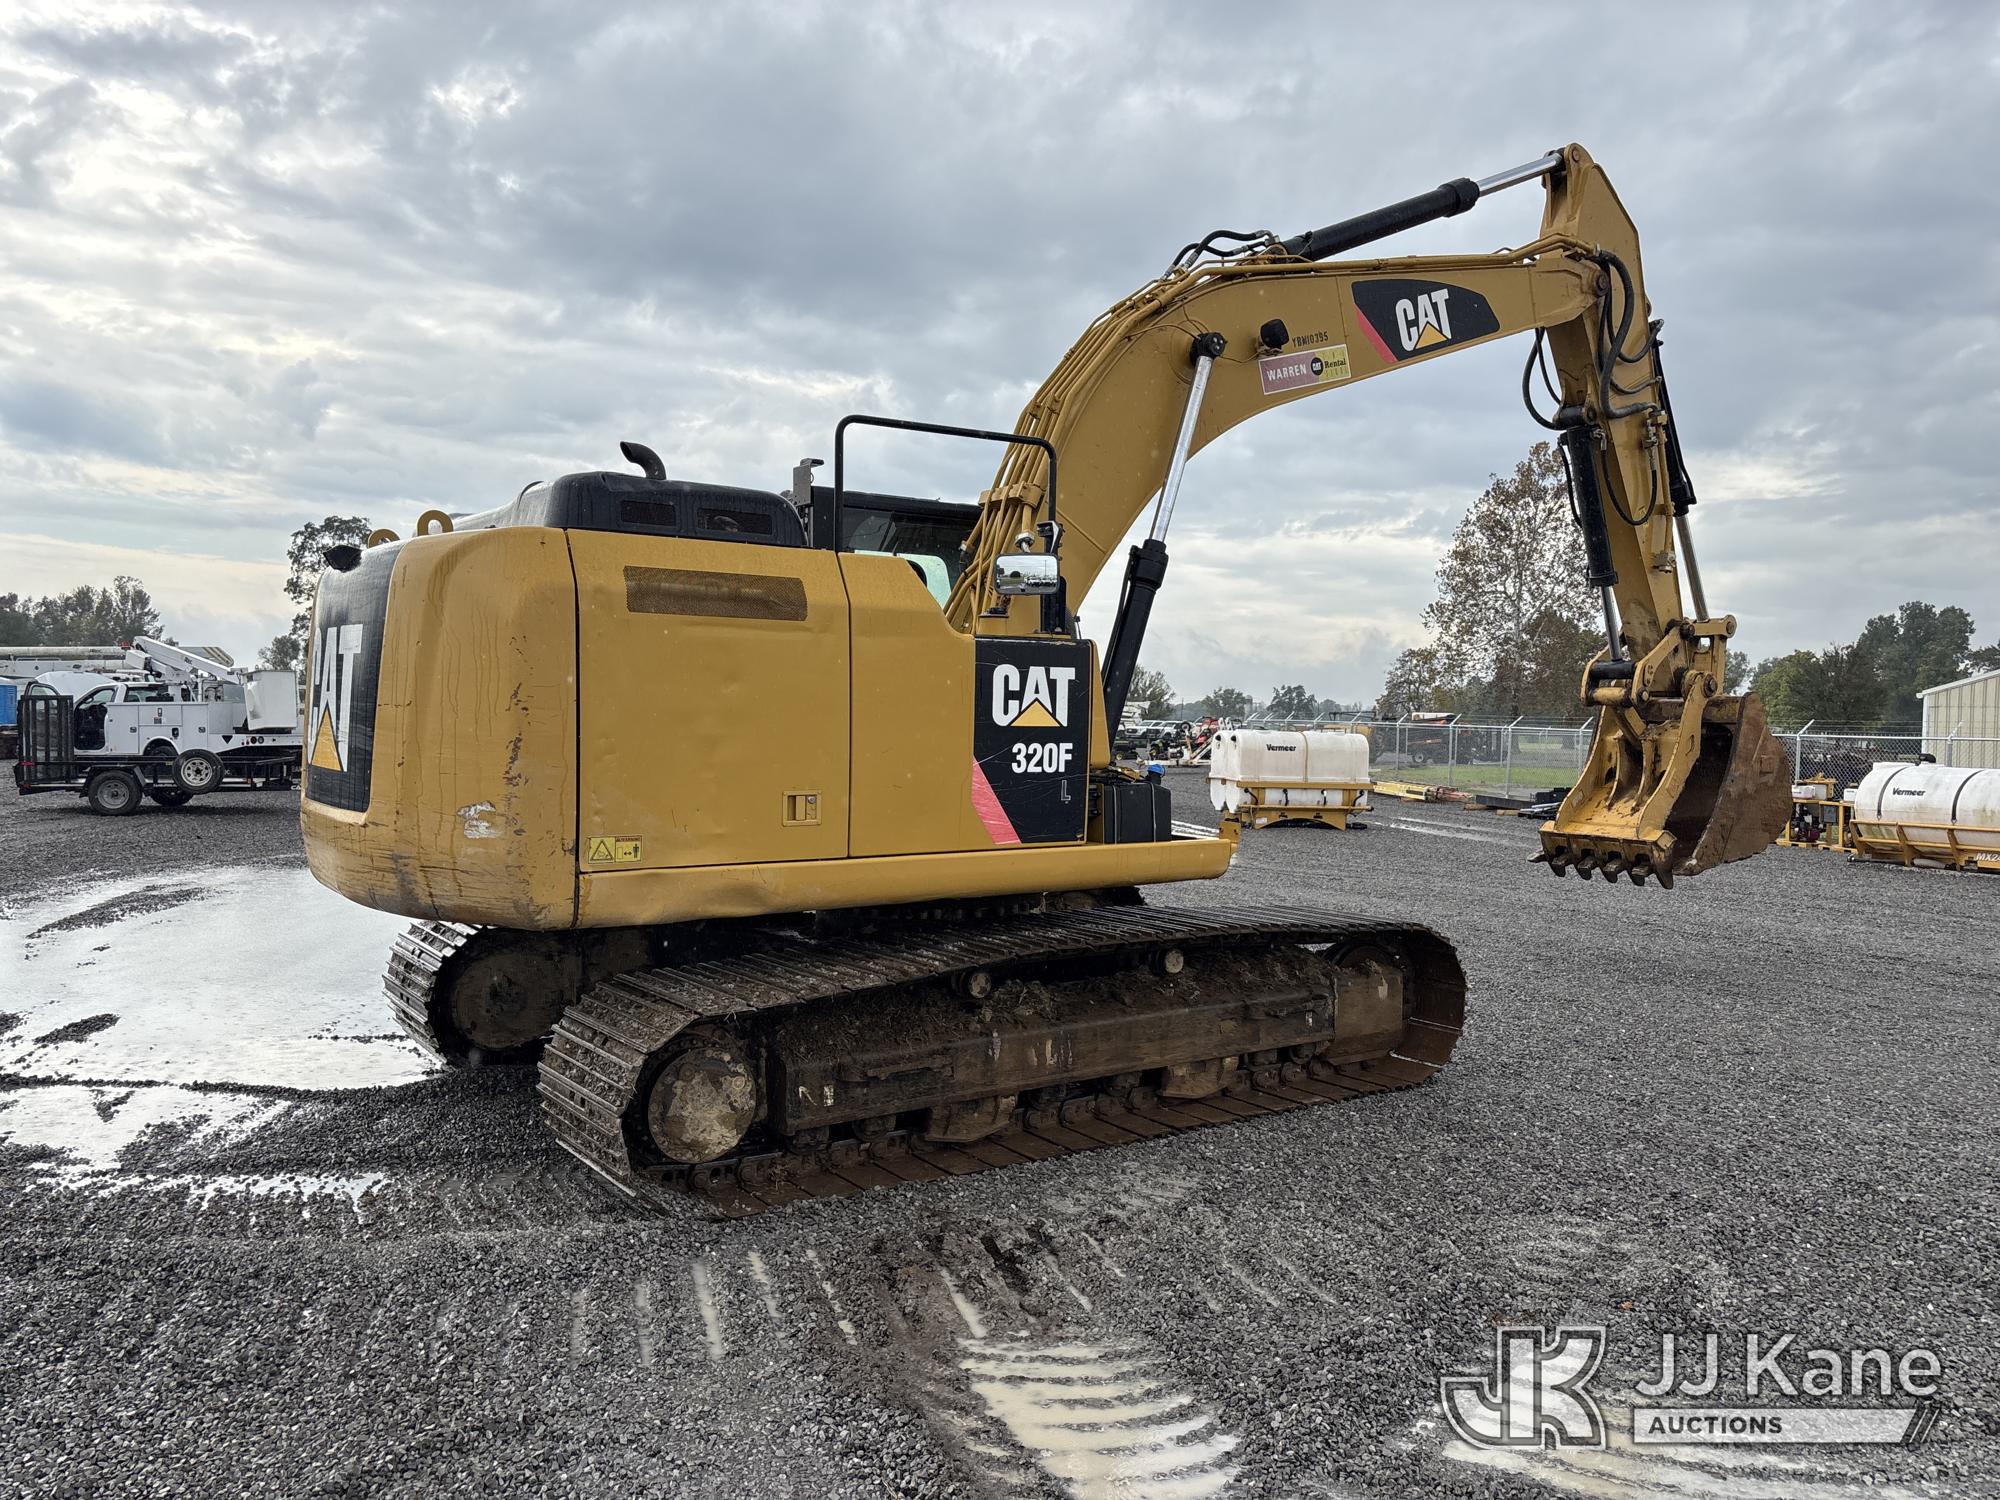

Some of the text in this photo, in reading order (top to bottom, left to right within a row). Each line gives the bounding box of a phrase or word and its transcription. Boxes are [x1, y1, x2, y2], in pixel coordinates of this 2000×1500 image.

[1395, 288, 1452, 351] CAT
[1266, 363, 1307, 381] WARREN
[1324, 358, 1346, 369] Rental
[307, 624, 363, 772] CAT
[992, 663, 1076, 727] CAT
[1011, 742, 1073, 774] 320F
[1266, 743, 1297, 752] Vermeer
[1892, 787, 1926, 797] Vermeer
